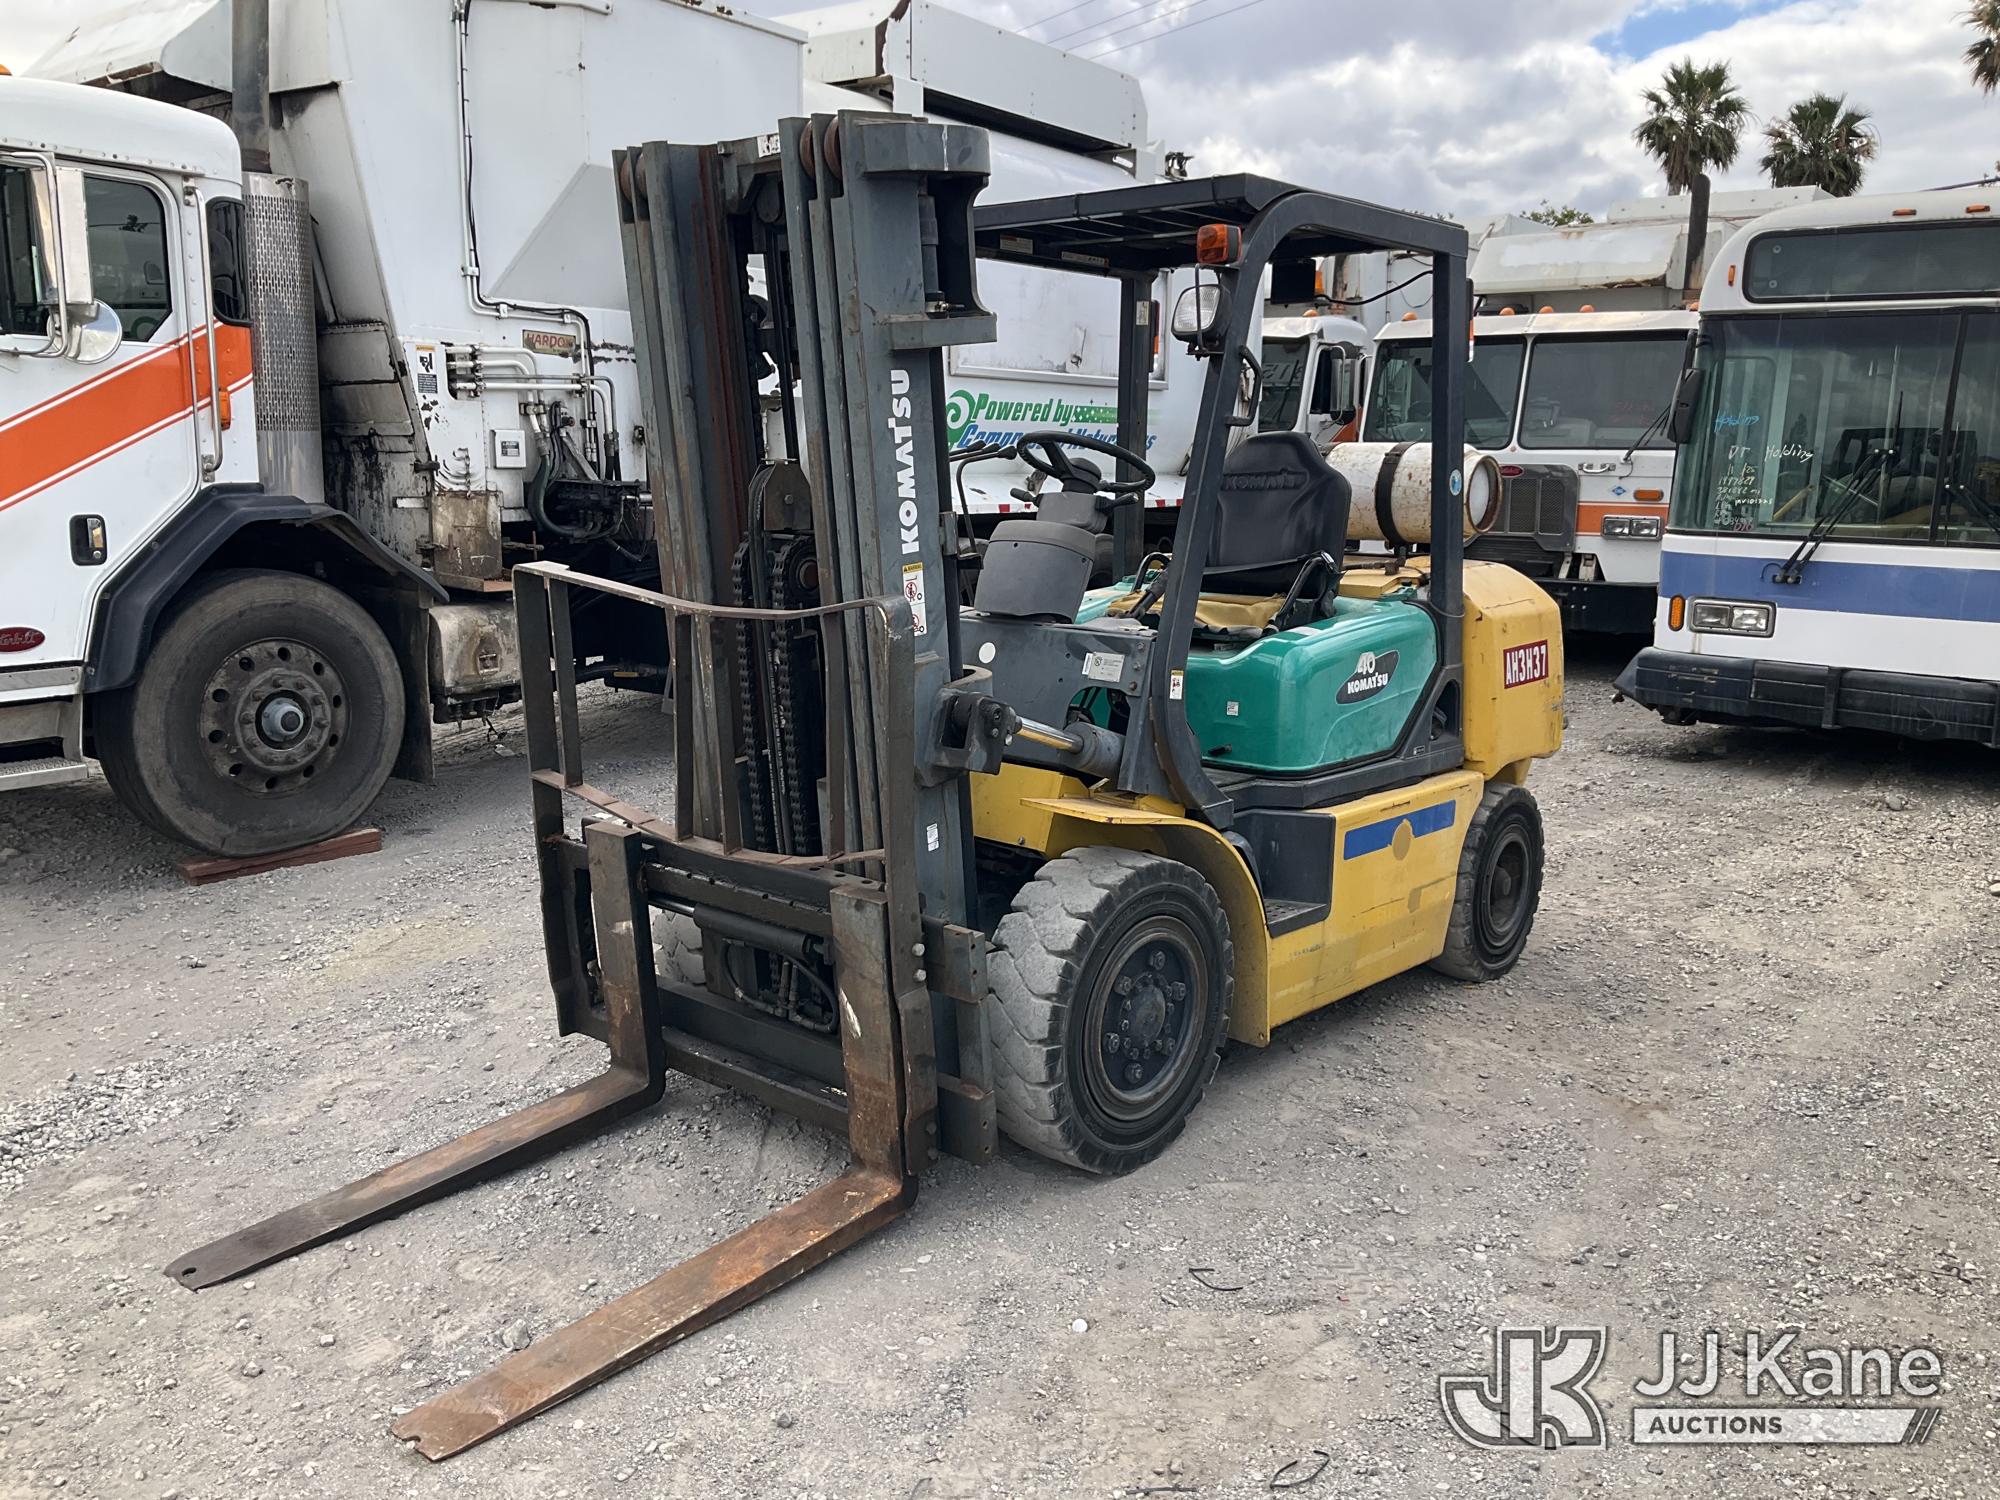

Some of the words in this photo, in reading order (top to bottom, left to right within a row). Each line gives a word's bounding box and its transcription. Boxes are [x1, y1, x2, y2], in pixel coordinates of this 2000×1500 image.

[526, 332, 573, 351] HARDO
[971, 393, 1053, 422] Powered
[1052, 399, 1075, 426] by
[888, 369, 920, 554] KOMATSU
[1728, 445, 1751, 460] DT
[1764, 443, 1814, 463] Holding
[1357, 651, 1376, 675] 40
[1505, 644, 1546, 686] AH3H37
[1347, 671, 1389, 694] KOMATSU
